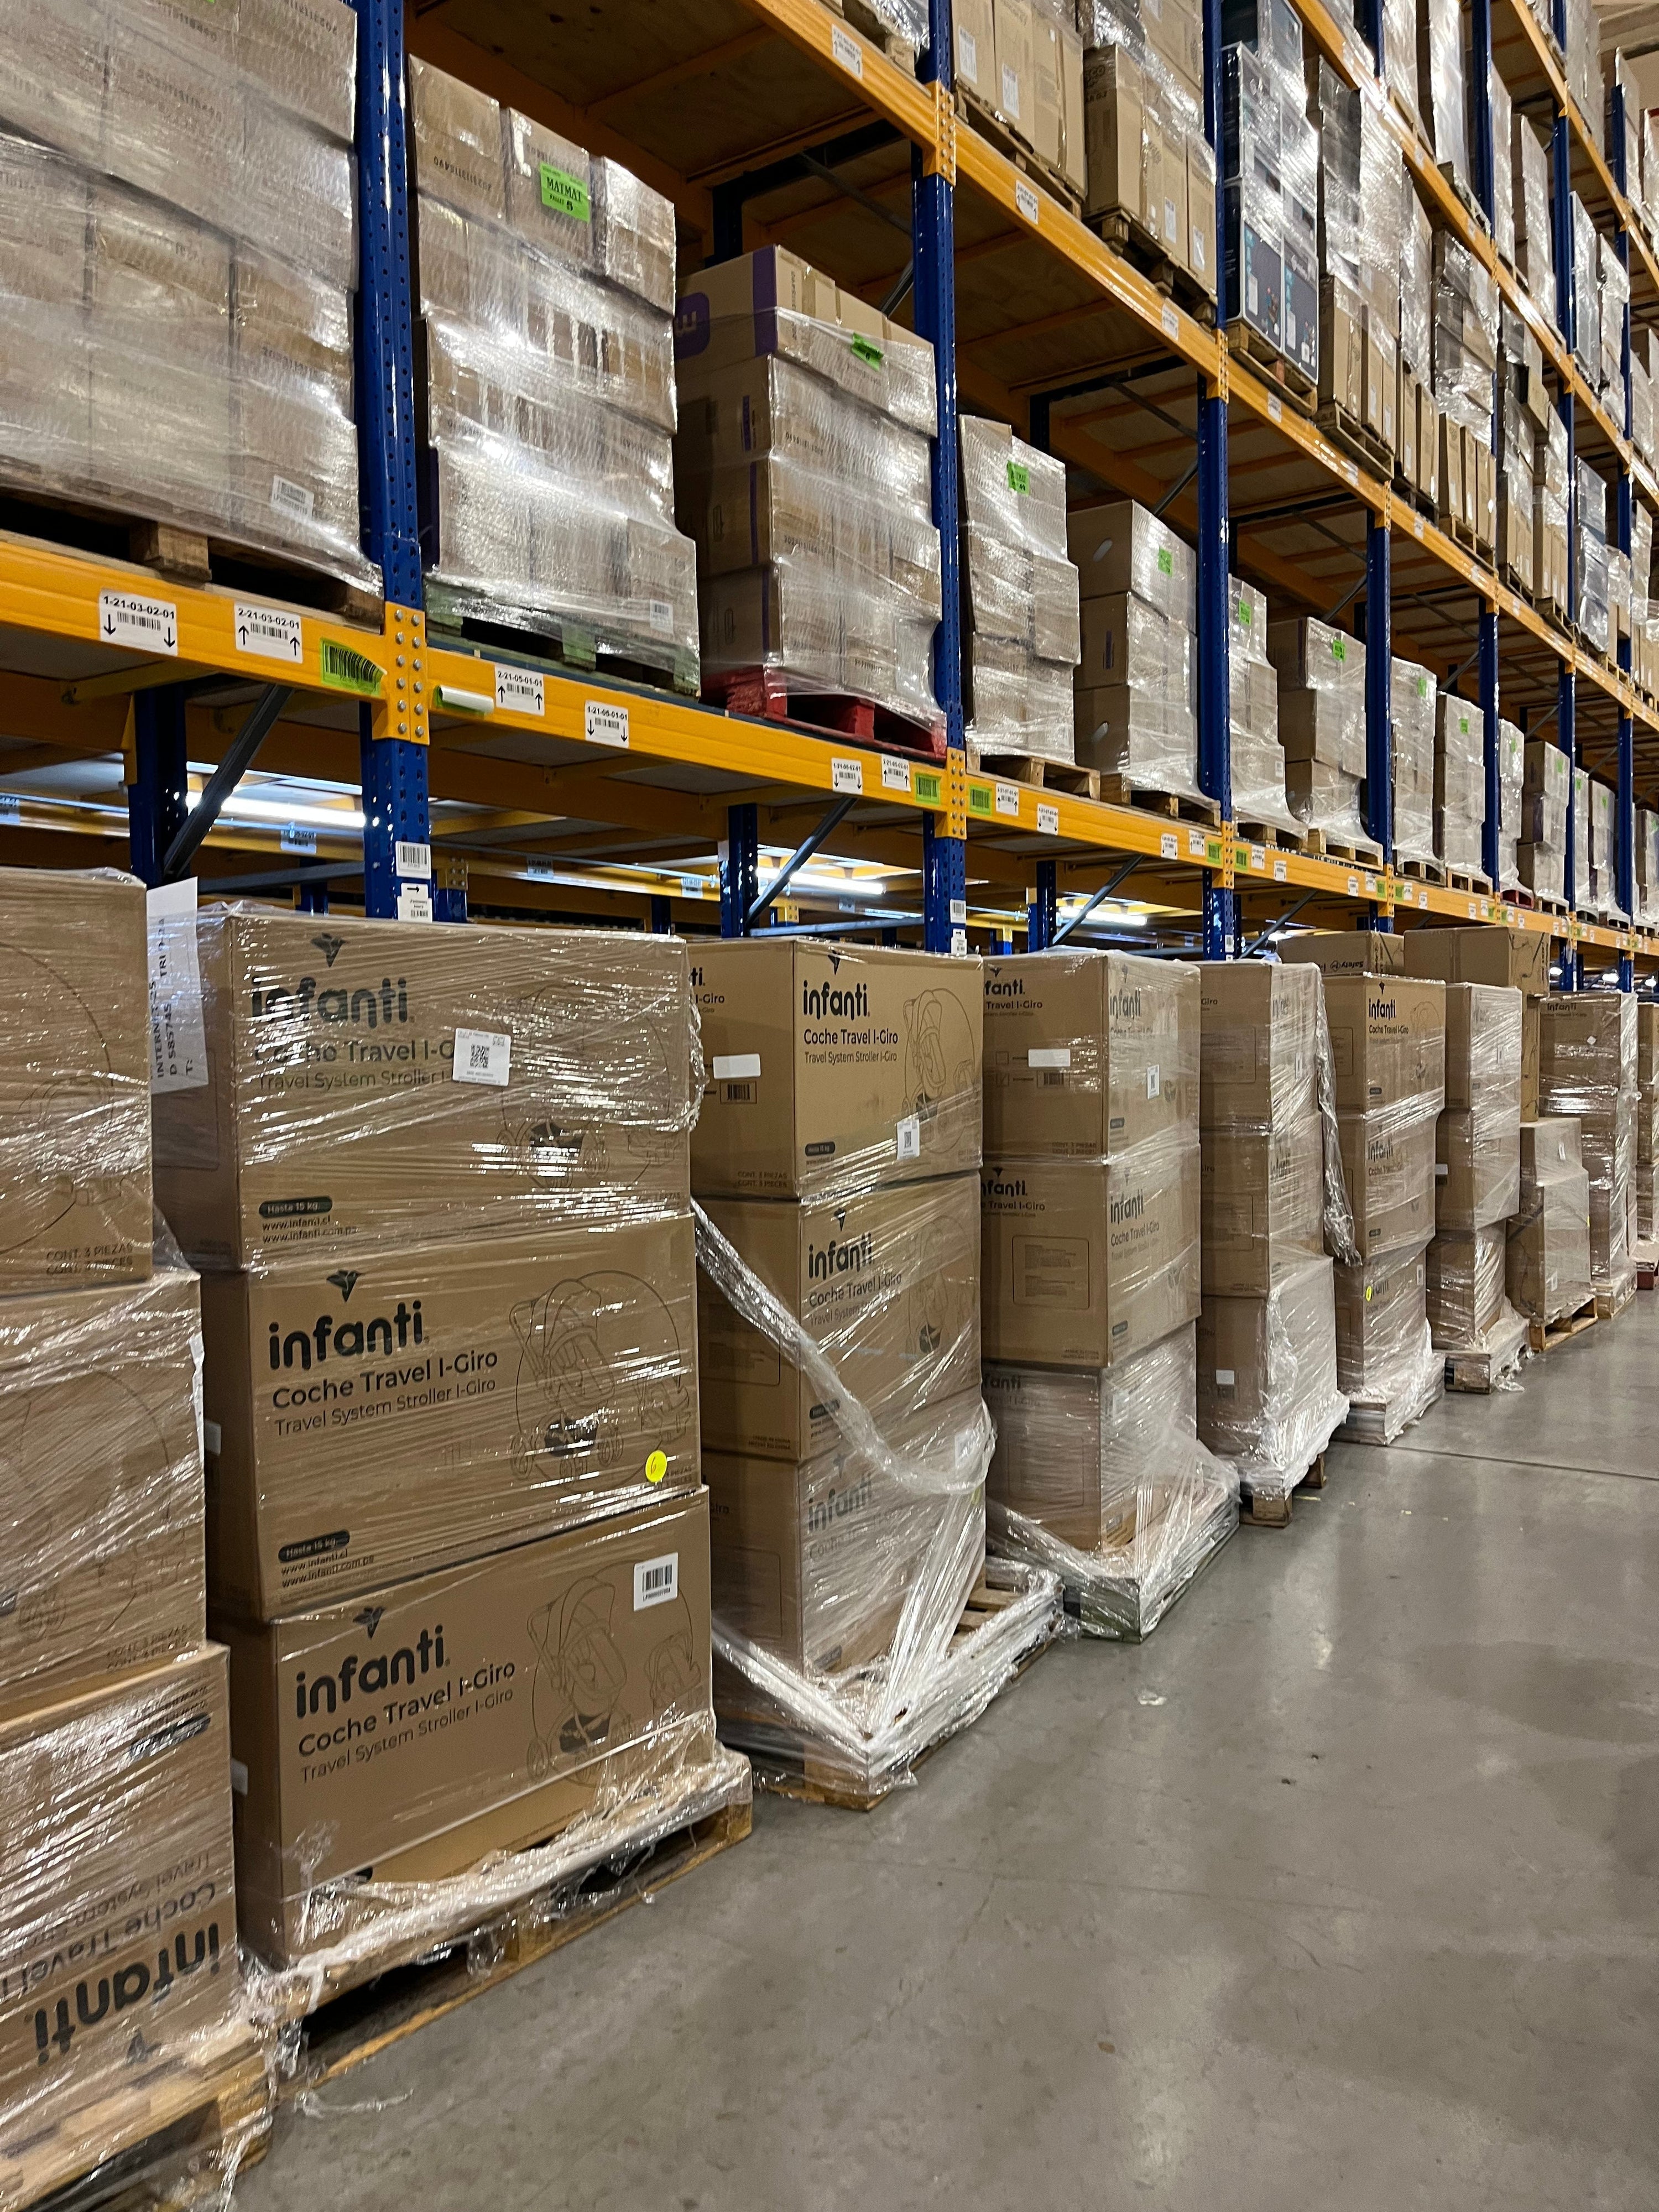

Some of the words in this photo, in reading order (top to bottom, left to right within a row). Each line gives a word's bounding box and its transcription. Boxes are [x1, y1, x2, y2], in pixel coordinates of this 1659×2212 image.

[103, 596, 175, 619] 1-21-03-02-01
[238, 608, 300, 630] 2-21-03-02-01
[498, 671, 542, 687] 2-21-05-01-01
[587, 706, 627, 721] 1-21-05-01-01
[696, 993, 725, 1004] I-Giro
[984, 978, 1023, 997] fanti
[252, 975, 408, 1029] infanti
[804, 980, 867, 1020] infanti
[986, 1000, 1014, 1009] Travel
[1016, 1000, 1042, 1009] I-Giro
[1369, 998, 1396, 1021] infanti
[804, 1027, 838, 1045] Coche
[841, 1028, 870, 1045] Travel
[873, 1028, 898, 1045] I-Giro
[347, 1039, 415, 1062] Travel
[805, 1051, 827, 1063] Travel
[828, 1051, 854, 1066] System
[855, 1051, 879, 1063] Stroller
[258, 1075, 309, 1091] Travel
[315, 1071, 376, 1091] System
[381, 1067, 436, 1085] Stroller
[981, 1180, 1026, 1197] nfanti
[988, 1200, 1016, 1209] Travel
[1110, 1189, 1143, 1225] infanti
[808, 1233, 872, 1280] infanti
[847, 1275, 875, 1299] Travel
[268, 1300, 423, 1371] infanti
[273, 1380, 353, 1408] Coche
[360, 1359, 431, 1392] Travel
[439, 1349, 498, 1378] I-Giro
[275, 1411, 326, 1436] Travel
[332, 1399, 392, 1426] System
[397, 1387, 451, 1411] Stroller
[456, 1378, 496, 1398] I-Giro
[296, 1624, 444, 1719] infanti
[299, 1715, 377, 1757] Coche
[384, 1681, 451, 1724] Travel
[459, 1662, 515, 1697] I-Giro
[302, 1749, 350, 1783] Travel
[356, 1728, 414, 1762] System
[419, 1706, 471, 1738] Stroller
[474, 1689, 513, 1714] I-Giro
[34, 1923, 220, 2067] infanti
